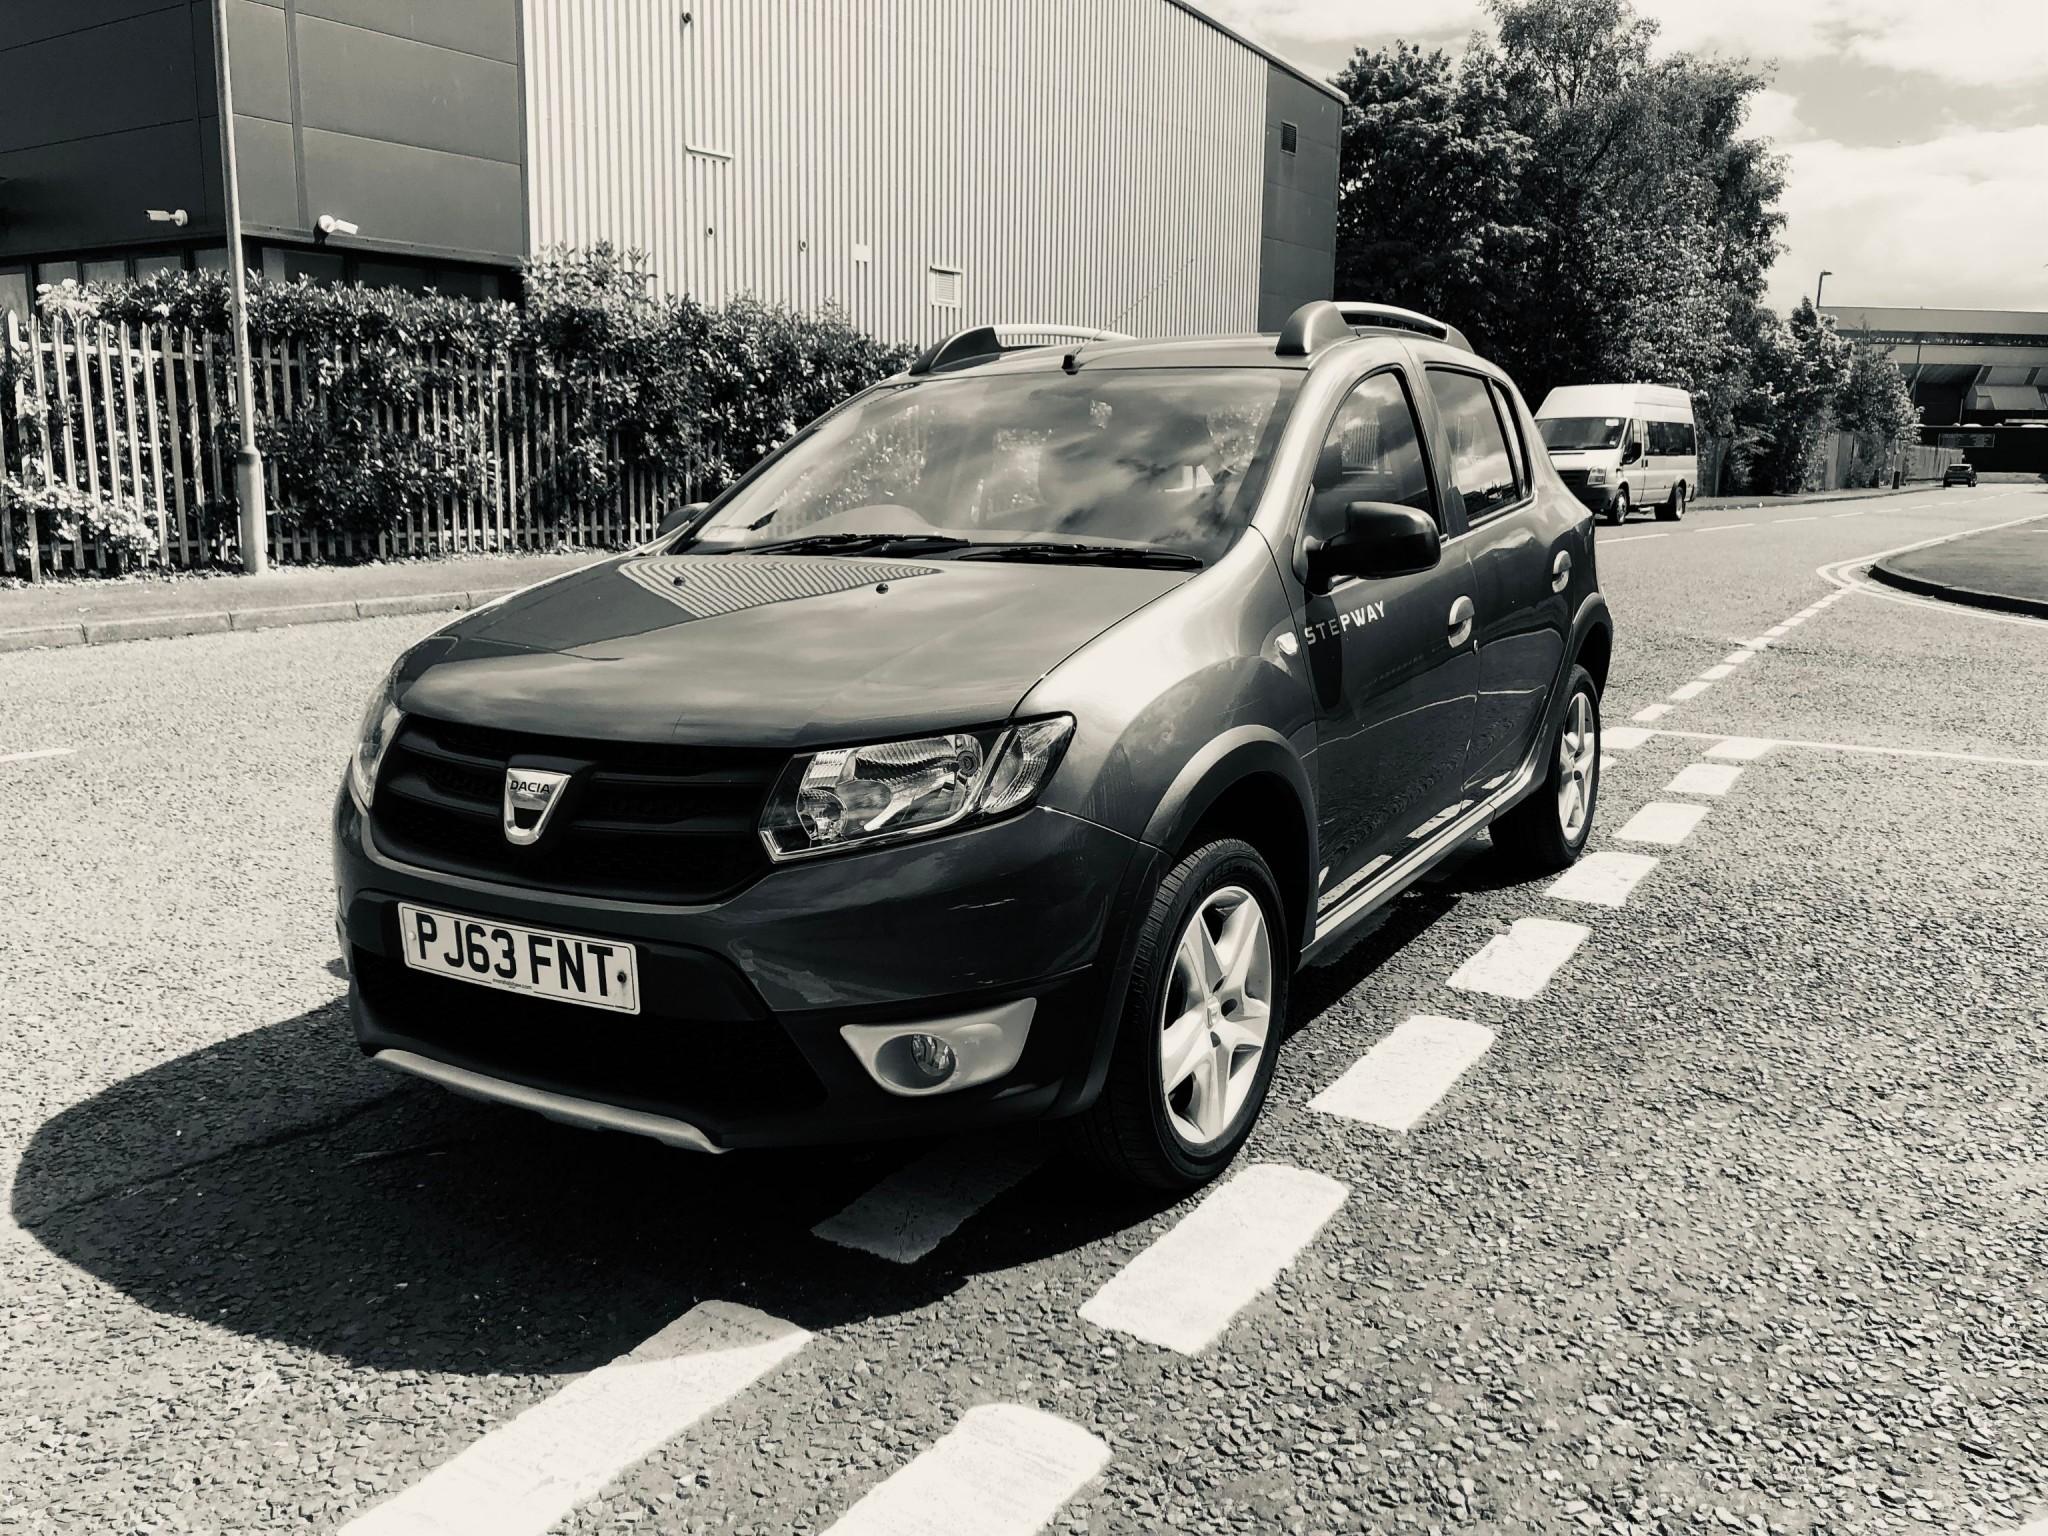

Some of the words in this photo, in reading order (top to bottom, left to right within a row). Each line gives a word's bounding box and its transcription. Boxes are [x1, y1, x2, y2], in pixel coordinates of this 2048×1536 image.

[1304, 600, 1385, 645] STEPWAY
[510, 780, 551, 793] DACIA
[415, 912, 517, 979] PJ63
[527, 934, 614, 997] FNT
